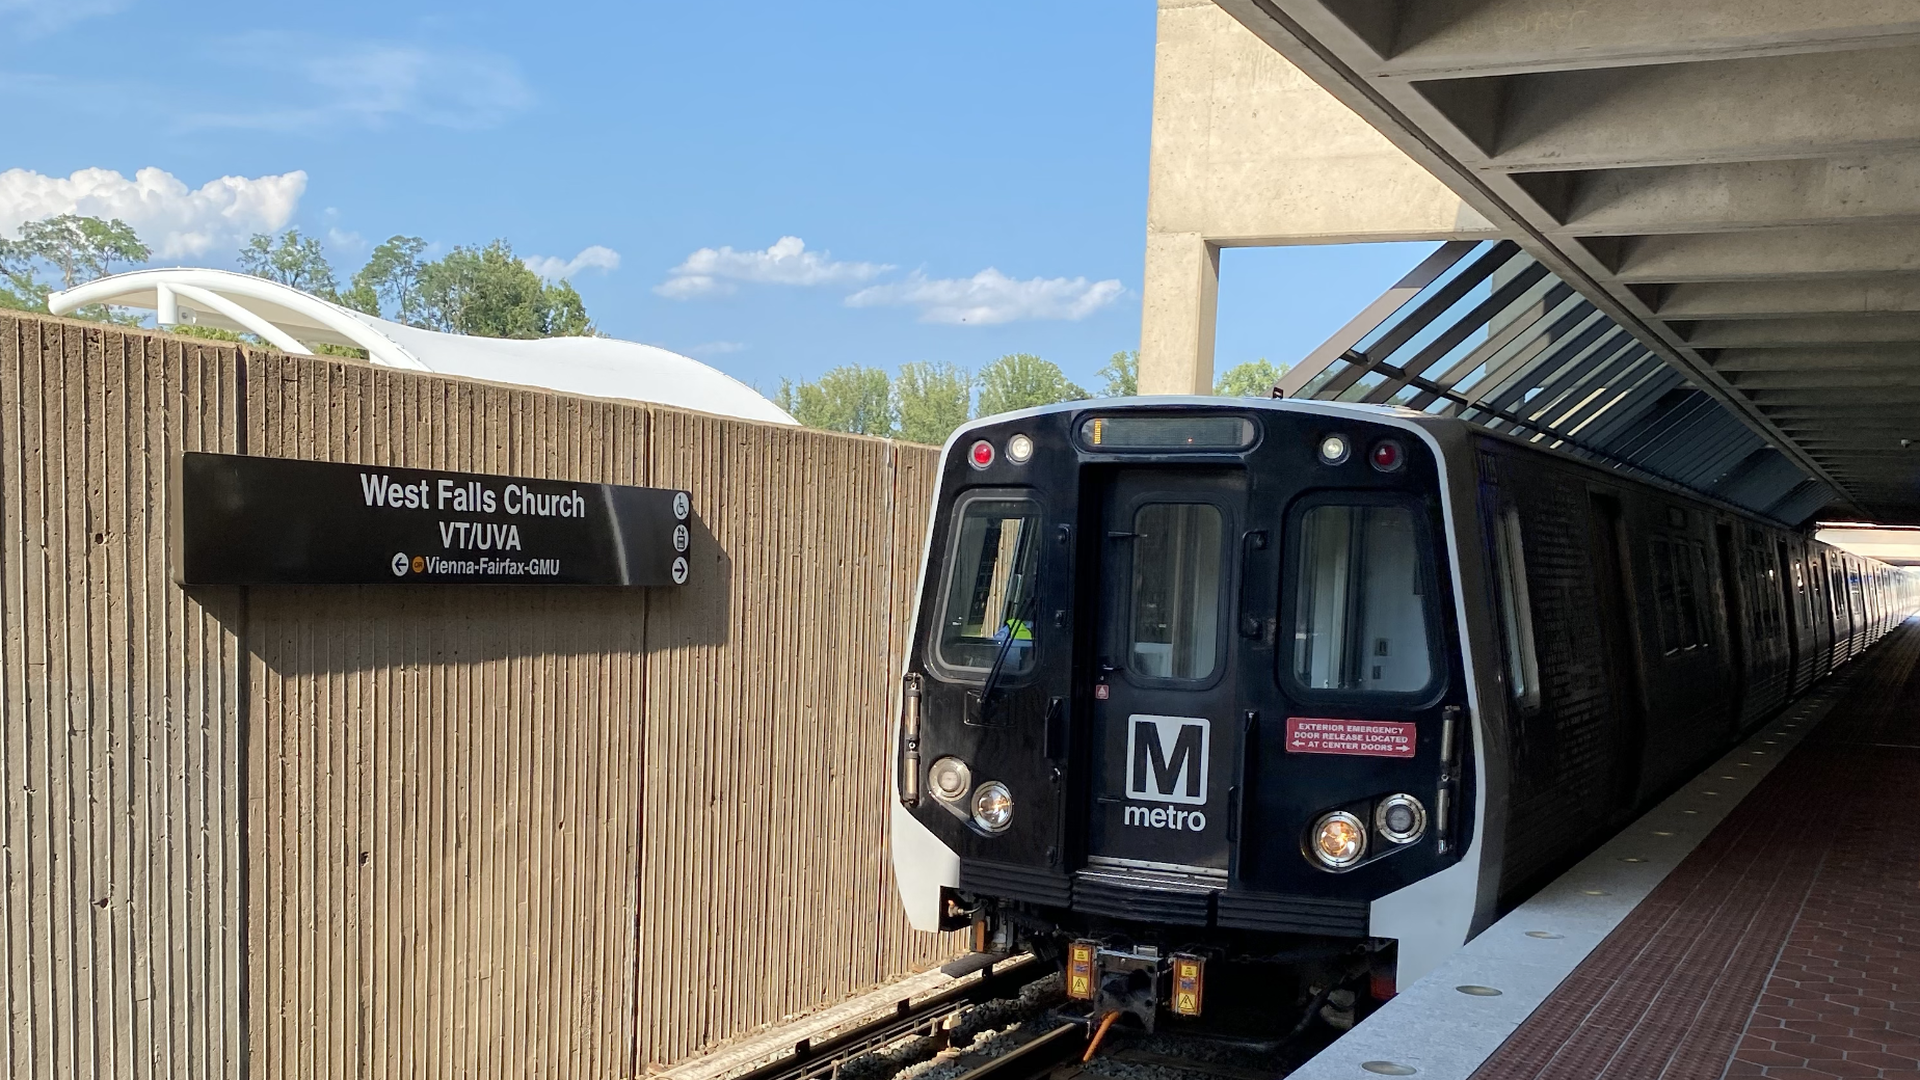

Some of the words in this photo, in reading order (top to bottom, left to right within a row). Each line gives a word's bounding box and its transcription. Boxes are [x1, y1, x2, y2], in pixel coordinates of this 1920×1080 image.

[360, 473, 429, 509] West
[438, 479, 496, 514] Falls
[504, 484, 585, 518] Church
[439, 521, 521, 551] VT/UVA
[425, 556, 560, 576] Vienna-Fairfax-GMU
[1294, 731, 1320, 739] DOOR
[1322, 732, 1363, 741] RELEASE
[1366, 735, 1408, 743] LOCATED
[1298, 723, 1344, 732] EXTERIOR
[1347, 725, 1404, 734] EMERGENCY
[1322, 741, 1359, 750] CENTER
[1361, 743, 1393, 751] DOORS
[1132, 721, 1204, 798] M
[1124, 805, 1206, 832] metro
